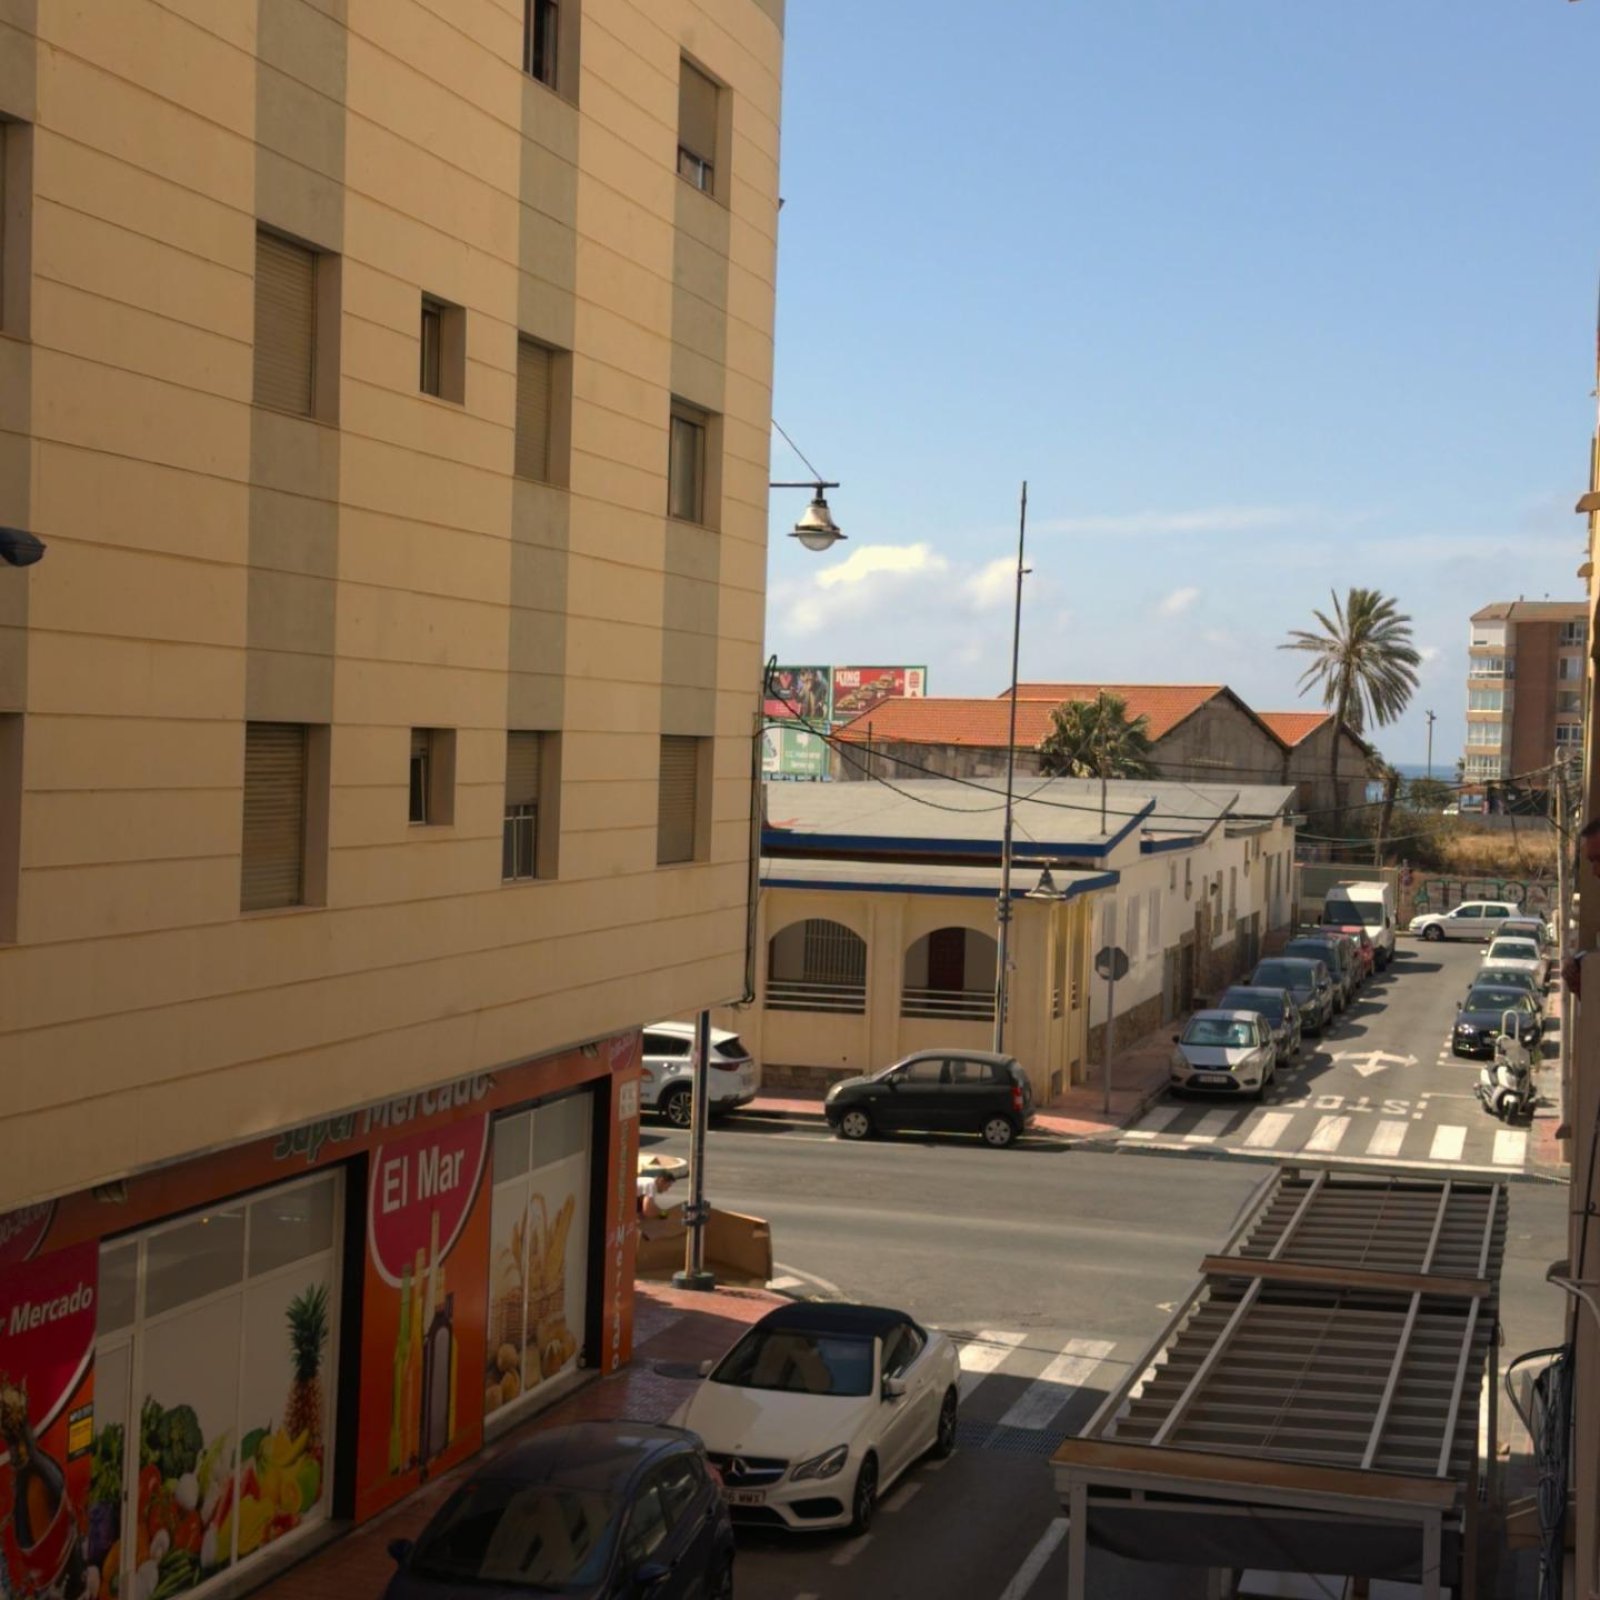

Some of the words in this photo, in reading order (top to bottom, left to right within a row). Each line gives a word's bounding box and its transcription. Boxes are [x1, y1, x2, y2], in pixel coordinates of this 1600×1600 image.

[382, 1156, 408, 1214] El
[418, 1145, 465, 1200] Mar
[8, 1281, 93, 1337] Mercado
